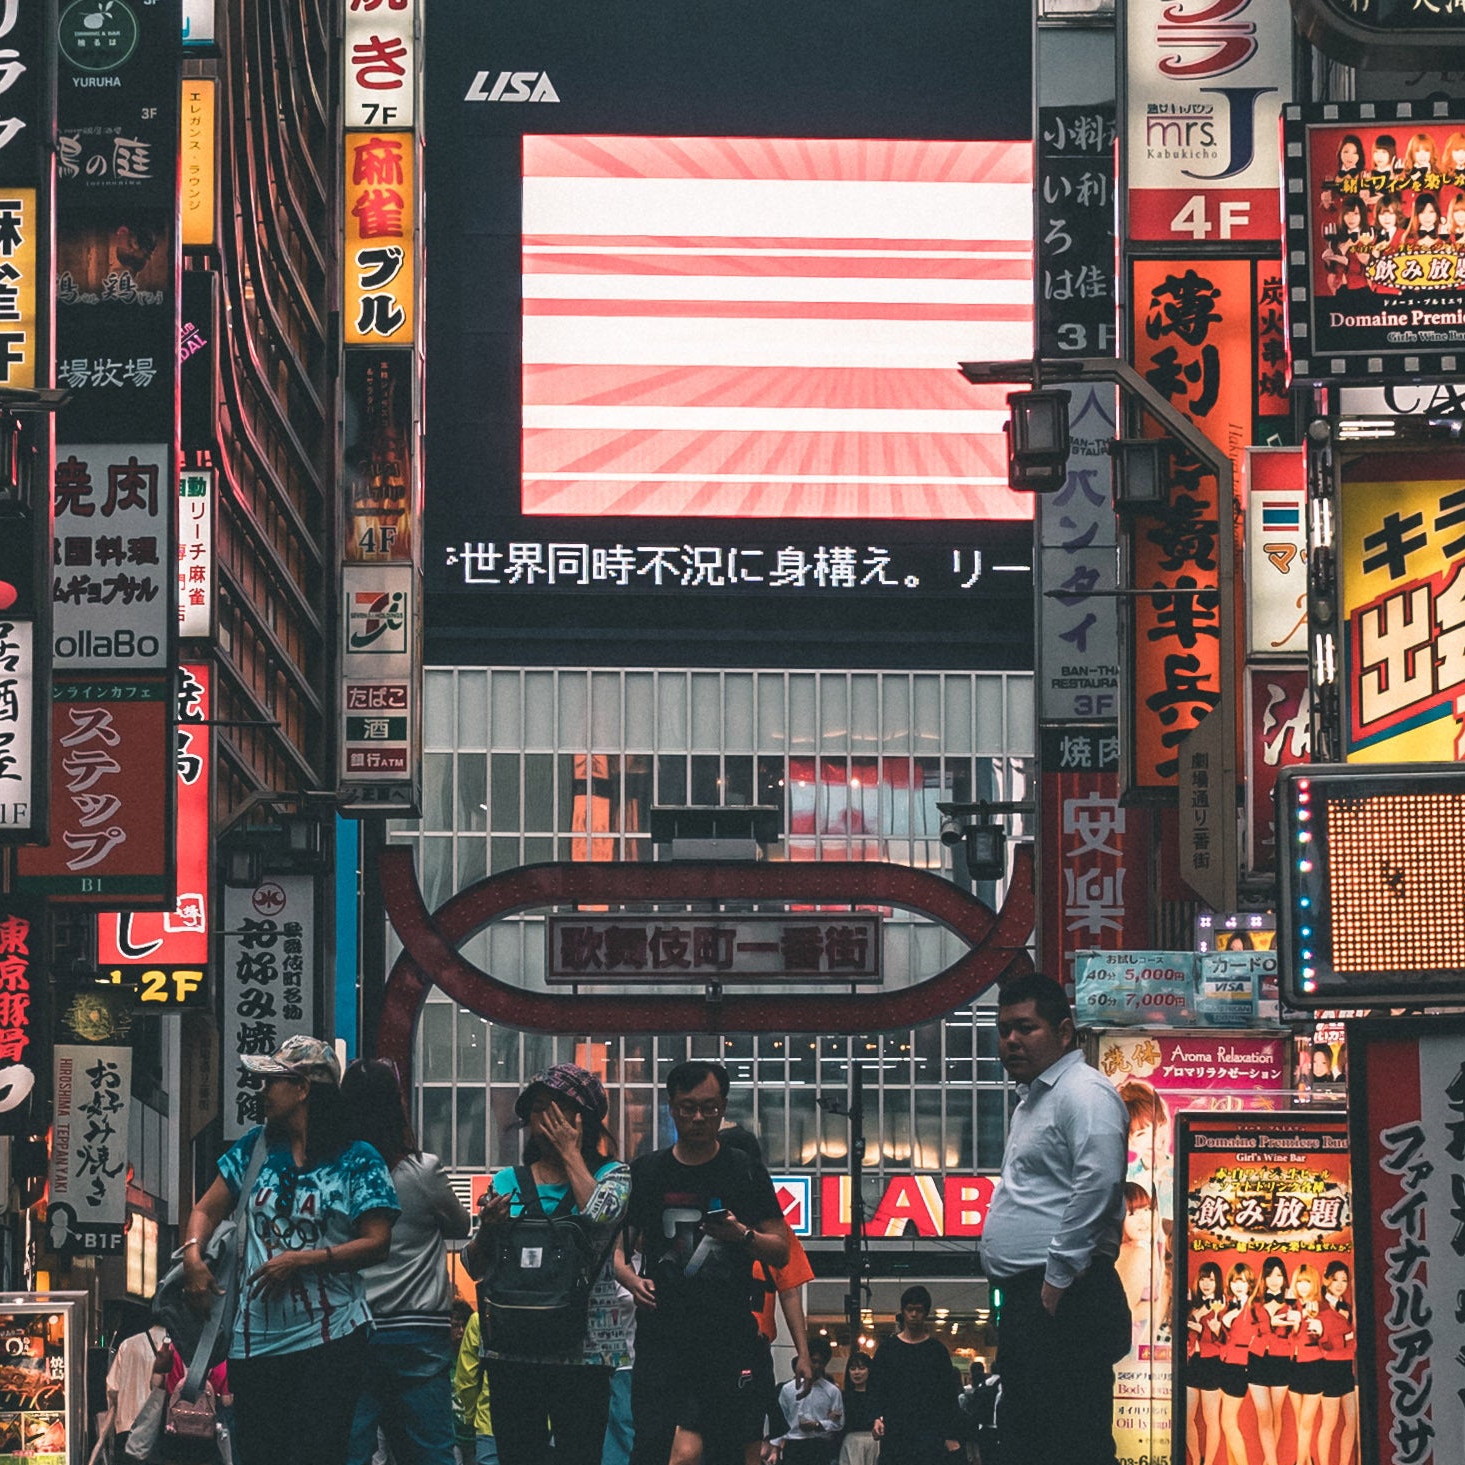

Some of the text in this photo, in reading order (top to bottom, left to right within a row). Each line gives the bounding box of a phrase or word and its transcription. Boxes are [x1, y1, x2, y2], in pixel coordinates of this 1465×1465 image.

[73, 77, 122, 88] YURUHA
[141, 108, 157, 119] 3F
[362, 104, 398, 125] 7F
[1147, 116, 1217, 147] mrs.
[190, 92, 201, 211] エレガンス・ラウンジ
[1147, 148, 1218, 160] Kabukicho
[352, 138, 403, 240] 麻雀
[1170, 195, 1250, 240] 4F
[355, 246, 405, 337] ブル
[1329, 310, 1408, 328] Domaine
[1387, 331, 1417, 343] Girl's
[1419, 331, 1448, 341] Wine
[359, 525, 397, 553] 4F
[55, 535, 159, 567] 国料理
[189, 502, 206, 606] リーチ麻雀
[1052, 469, 1107, 653] バンタイ
[460, 542, 921, 588] 世界同時不況に身構え。
[54, 630, 159, 658] ollaBo
[349, 688, 406, 708] たばこ
[1074, 695, 1114, 715] 3F
[364, 718, 389, 739] 酒
[351, 753, 404, 767] 銀行ATM
[60, 707, 127, 871] ステップ
[1191, 752, 1210, 870] 劇場通り一番街
[81, 878, 103, 892] B1
[560, 925, 868, 970] 歌舞伎町一番街
[1106, 955, 1164, 965] お試しコース
[1087, 969, 1185, 982] 40分 5,000円
[1214, 983, 1245, 993] VISA
[1088, 994, 1185, 1007] 60分 7,000円
[1171, 1045, 1274, 1064] Aroma Relaxation
[1163, 1066, 1281, 1080] アロマリラクゼーション
[54, 1058, 73, 1194] HIROSHIMA TEPPANYAKI
[76, 1058, 124, 1207] お好み焼き
[1194, 1135, 1257, 1148] Domaine
[1259, 1135, 1320, 1148] Premiere
[1236, 1153, 1306, 1162] Girl's Wine Bar
[1198, 1196, 1342, 1229] 飲み放題
[86, 1233, 122, 1248] B1F
[1118, 1384, 1146, 1396] Body
